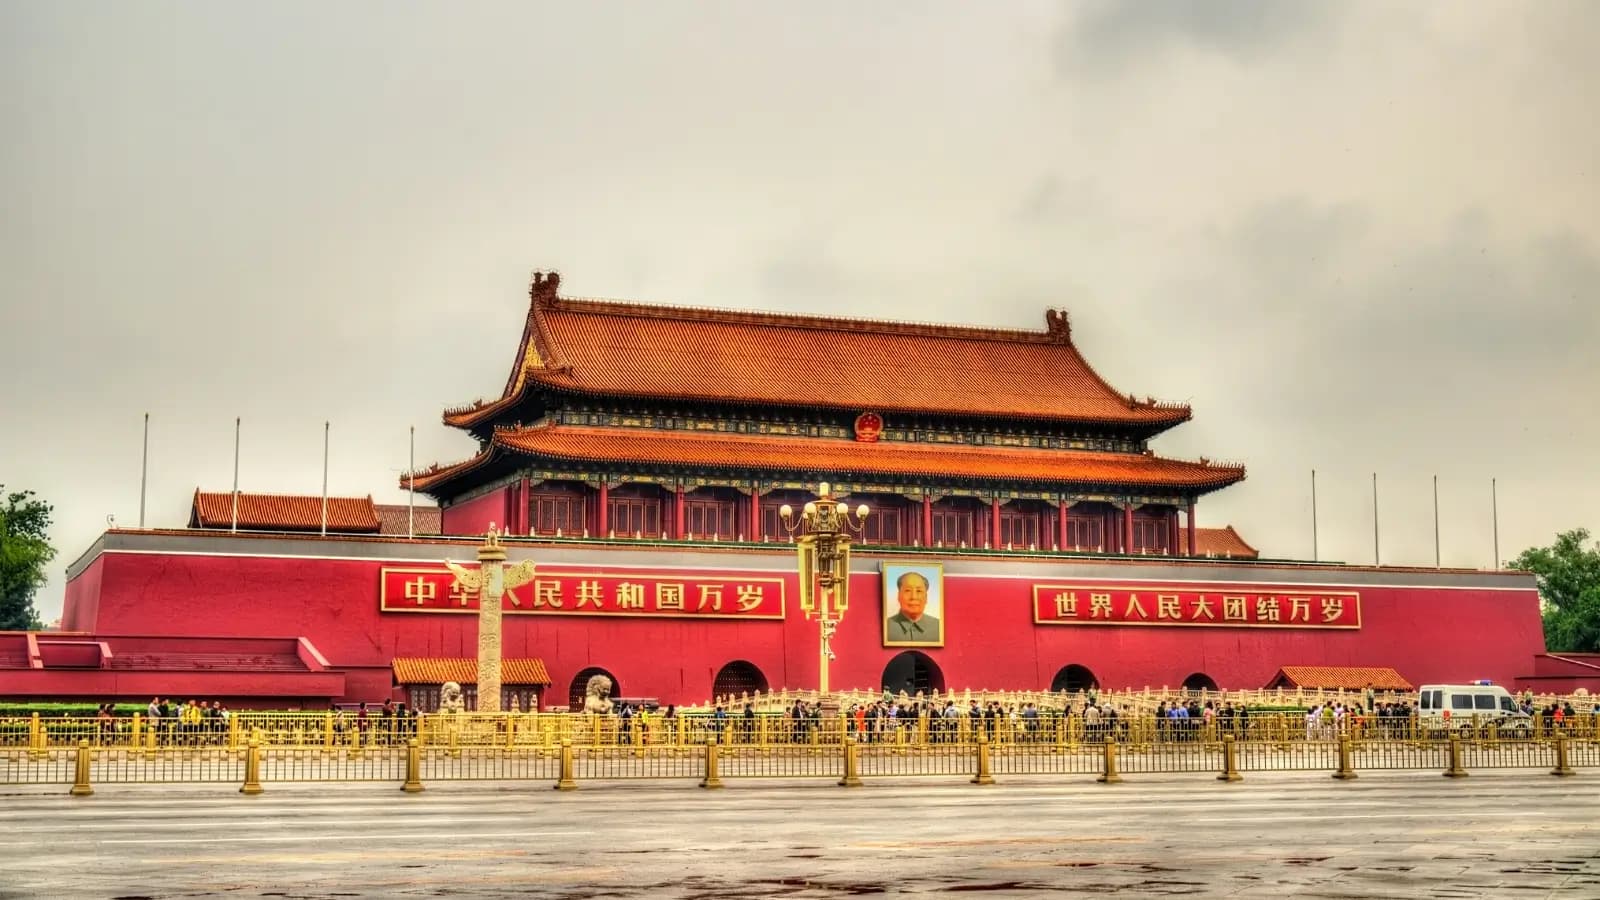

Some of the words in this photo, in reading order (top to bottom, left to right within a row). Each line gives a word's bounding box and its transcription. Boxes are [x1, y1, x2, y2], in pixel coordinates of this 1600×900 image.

[1054, 592, 1344, 623] 世界人民大团结万岁
